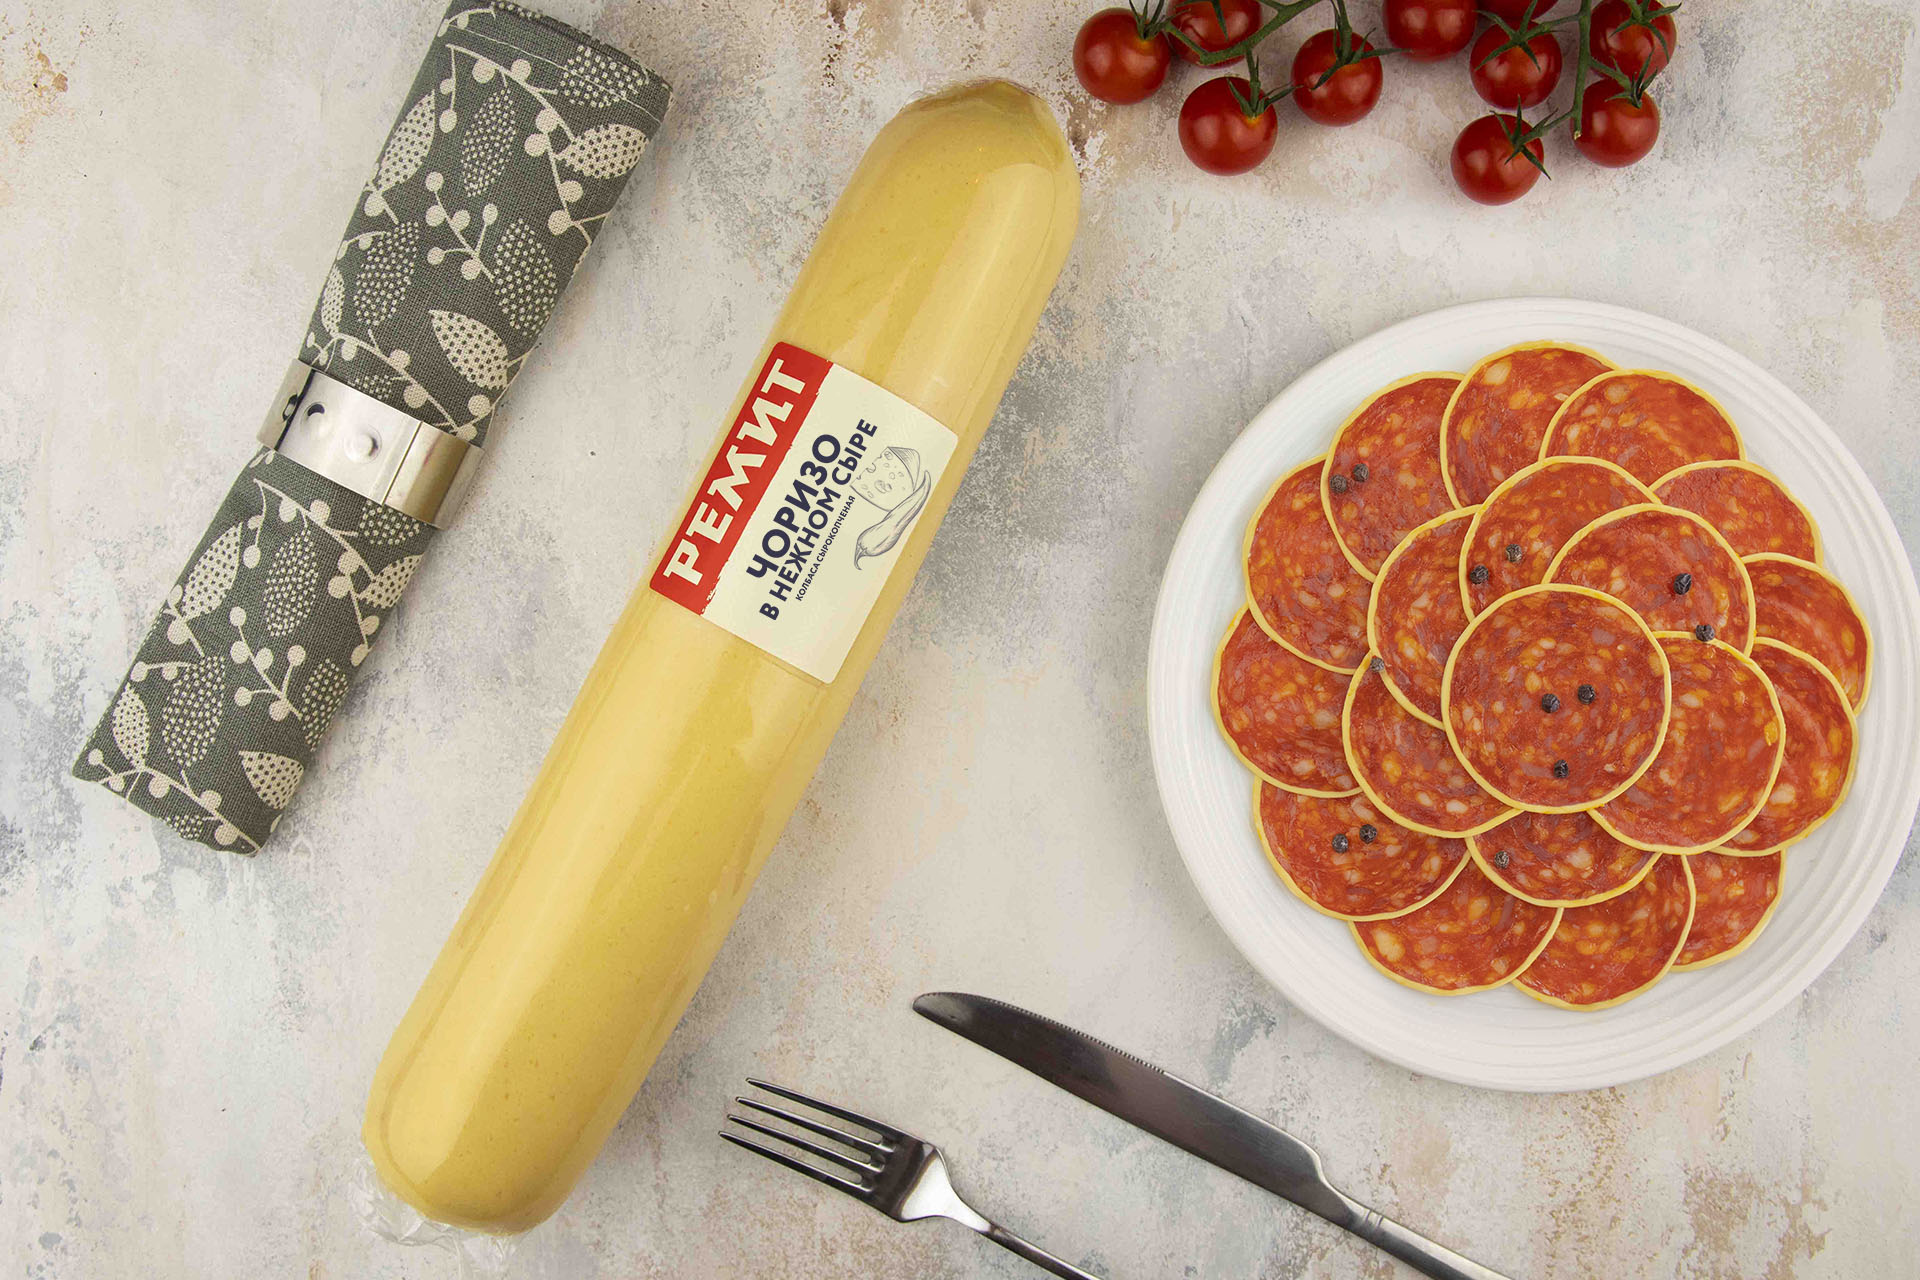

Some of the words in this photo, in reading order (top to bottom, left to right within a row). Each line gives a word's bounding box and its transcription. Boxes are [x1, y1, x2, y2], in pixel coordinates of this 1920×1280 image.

[663, 358, 806, 586] РЕМИТ
[746, 434, 841, 578] ЧОРИЗО
[831, 419, 878, 486] СЫРЕ
[769, 487, 842, 602] НЕЖНОМ
[795, 562, 820, 602] КОЛБАСА
[816, 495, 856, 564] СЫРОКОПЧЕНАЯ
[759, 602, 780, 620] В
